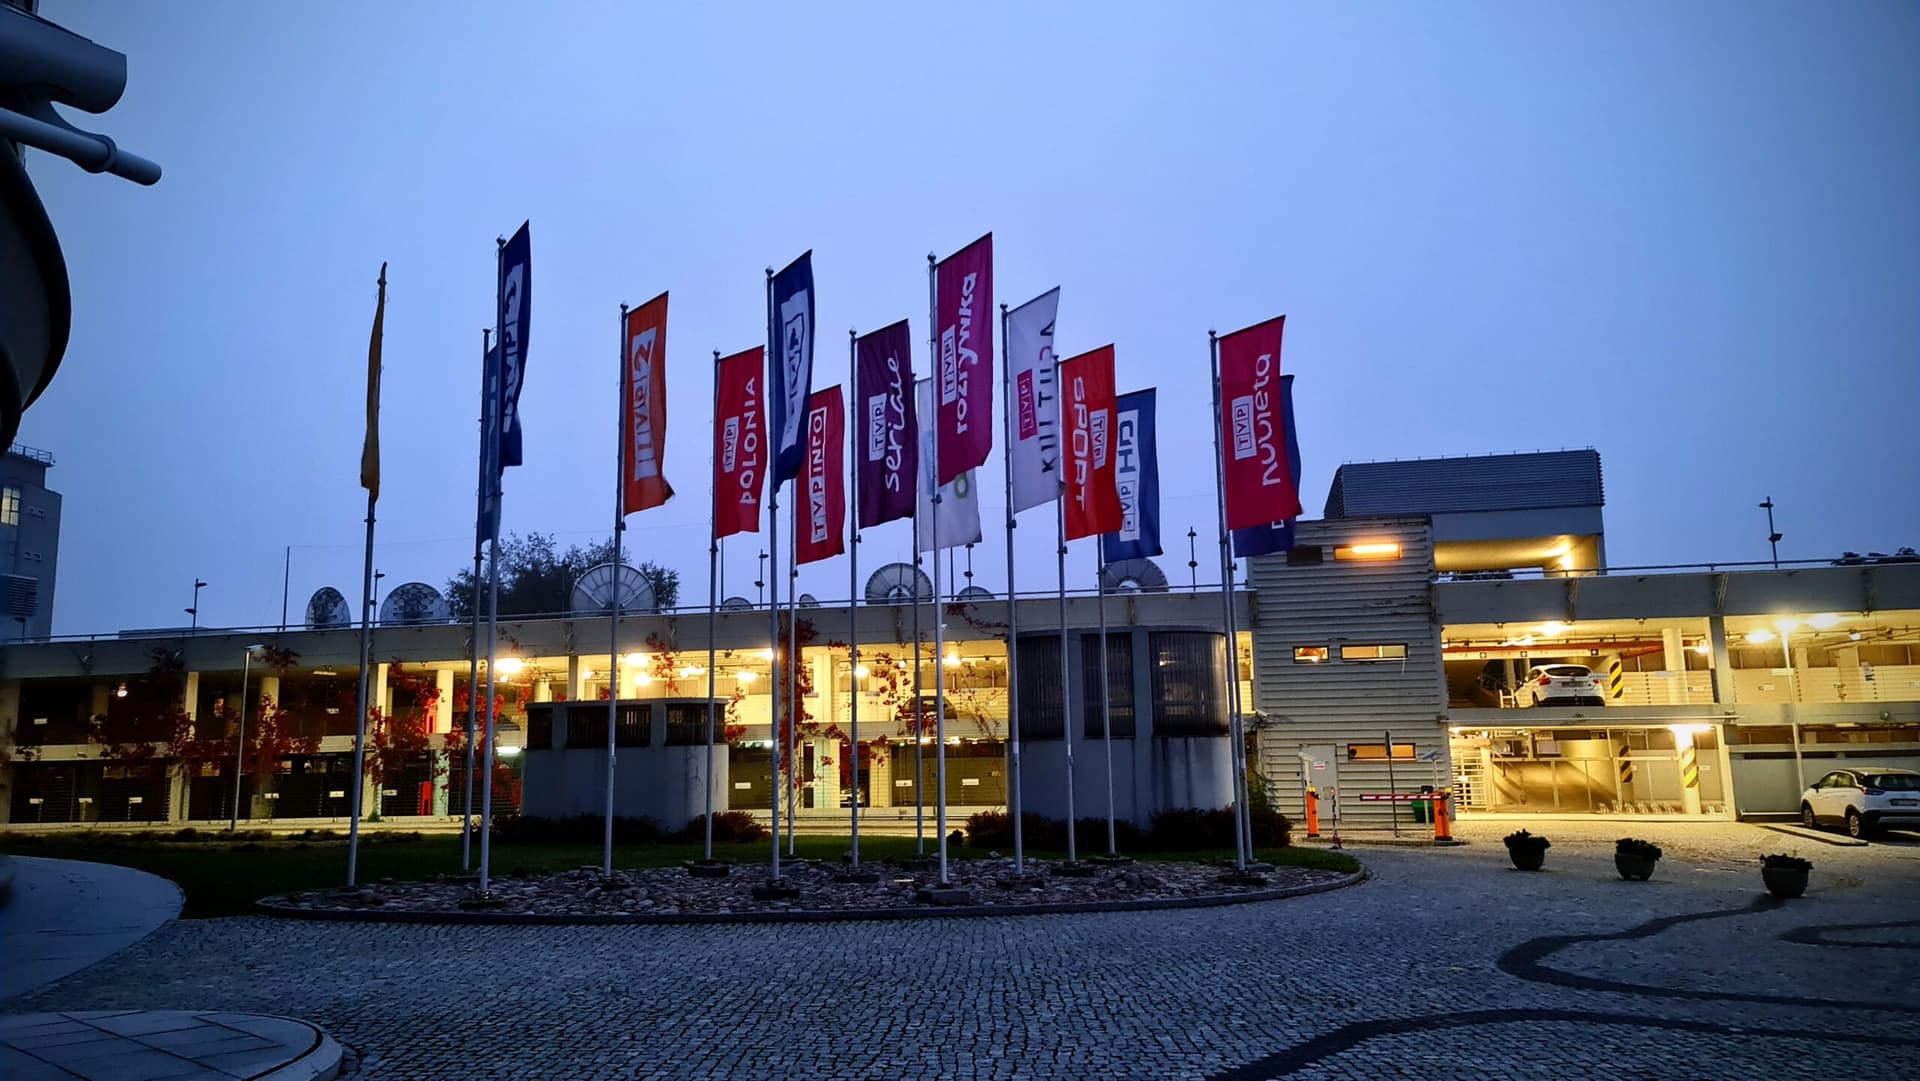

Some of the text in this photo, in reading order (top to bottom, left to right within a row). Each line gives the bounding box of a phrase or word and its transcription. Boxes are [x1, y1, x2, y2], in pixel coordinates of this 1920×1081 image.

[944, 339, 955, 390] TVP
[872, 406, 884, 449] TVP
[1020, 384, 1032, 426] TVP
[1237, 405, 1250, 449] TVP
[723, 426, 736, 464] TVP
[740, 377, 757, 504] POLONIA
[1073, 376, 1088, 511] SPORT
[1093, 418, 1104, 459] TVP
[812, 415, 824, 535] TVP INFO
[1119, 419, 1135, 528] VP HD
